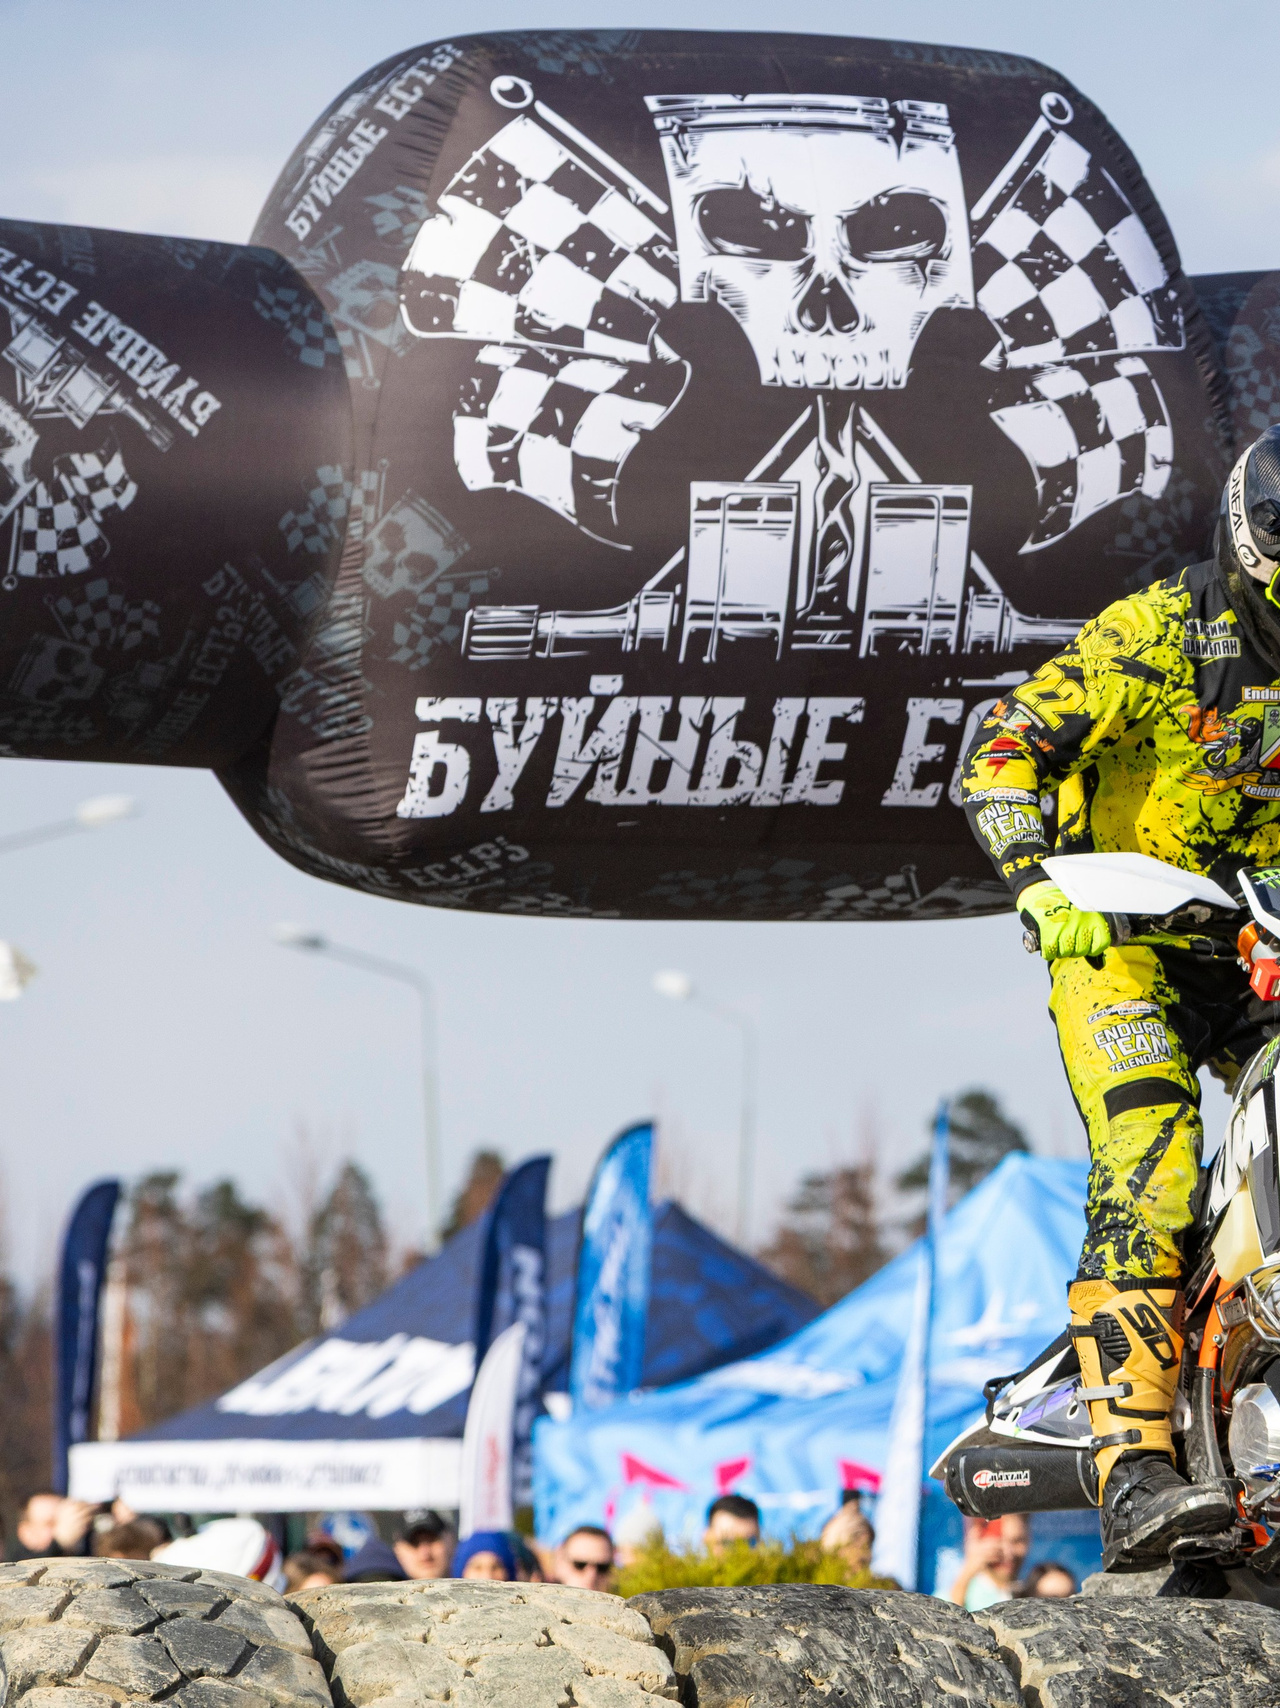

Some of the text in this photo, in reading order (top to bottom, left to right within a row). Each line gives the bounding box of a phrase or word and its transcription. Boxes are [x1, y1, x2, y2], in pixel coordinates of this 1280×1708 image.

[285, 117, 389, 241] БУЙНЫЕ
[70, 300, 222, 438] БУЙНЫЕ
[1013, 662, 1088, 732] 22
[397, 674, 866, 818] БУЙНЫЕ
[1094, 1022, 1167, 1047] ENDURO
[1099, 1034, 1173, 1062] TEAM
